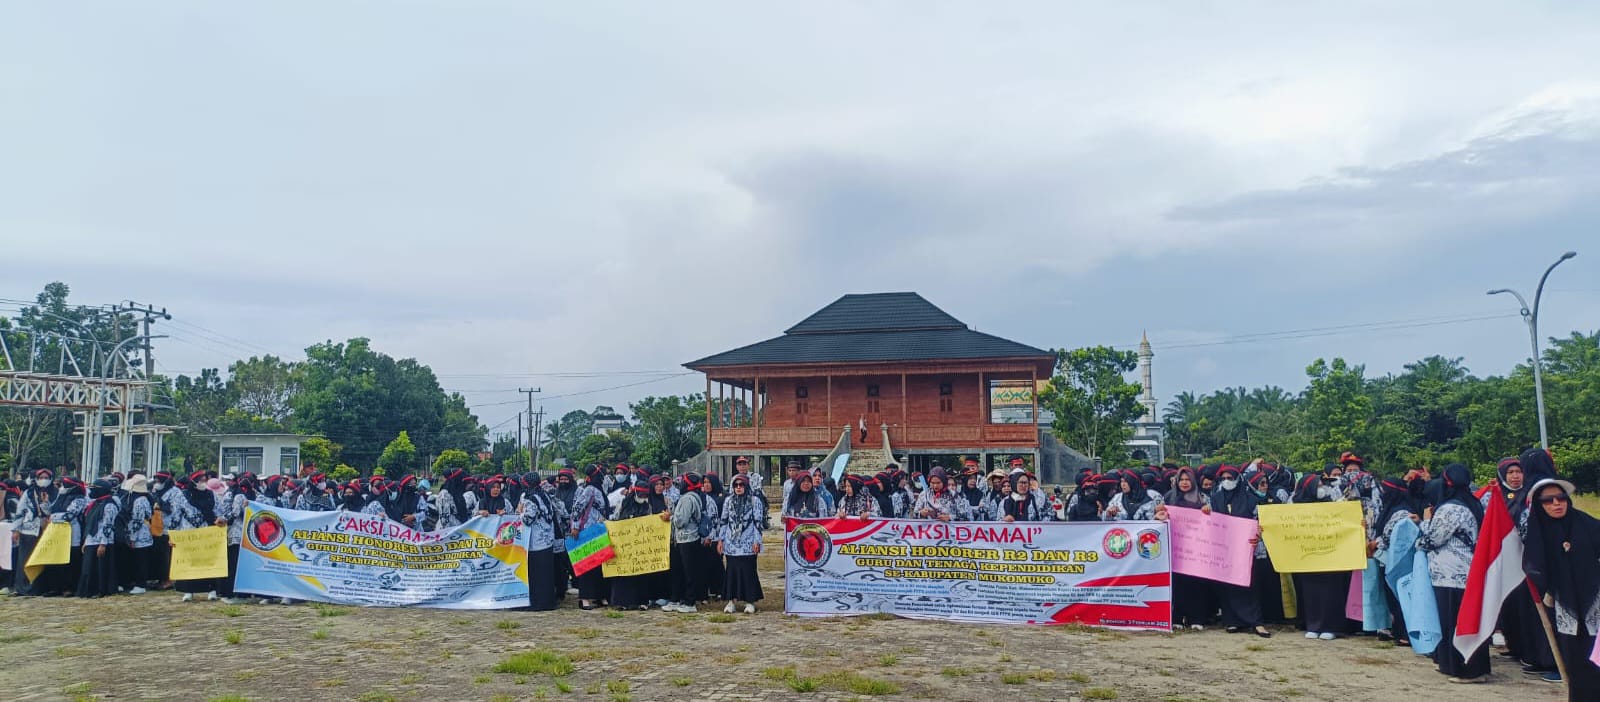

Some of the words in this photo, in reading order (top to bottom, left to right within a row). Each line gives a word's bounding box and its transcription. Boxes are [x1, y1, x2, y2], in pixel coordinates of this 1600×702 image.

[292, 529, 350, 544] ALIANSI
[352, 535, 418, 555] HONORER
[421, 544, 443, 554] R2
[446, 539, 472, 551] DAN
[476, 537, 493, 549] R3
[307, 542, 337, 553] GURU
[340, 546, 360, 555] DAN
[362, 548, 404, 562] TENAGA
[839, 543, 907, 556] ALIANSI
[911, 546, 999, 561] HONORER
[1003, 549, 1028, 561] R2
[1031, 550, 1069, 562] DAN
[1073, 550, 1098, 562] R3
[329, 553, 404, 570] SE-KABUPATEN
[856, 557, 892, 568] GURU
[895, 559, 922, 568] DAN
[925, 559, 977, 571] TENAGA
[979, 561, 1084, 574] KEPENDIDIKAN
[884, 569, 976, 581] SE-KABUPATEN
[978, 572, 1055, 584] MUKOMUKO
